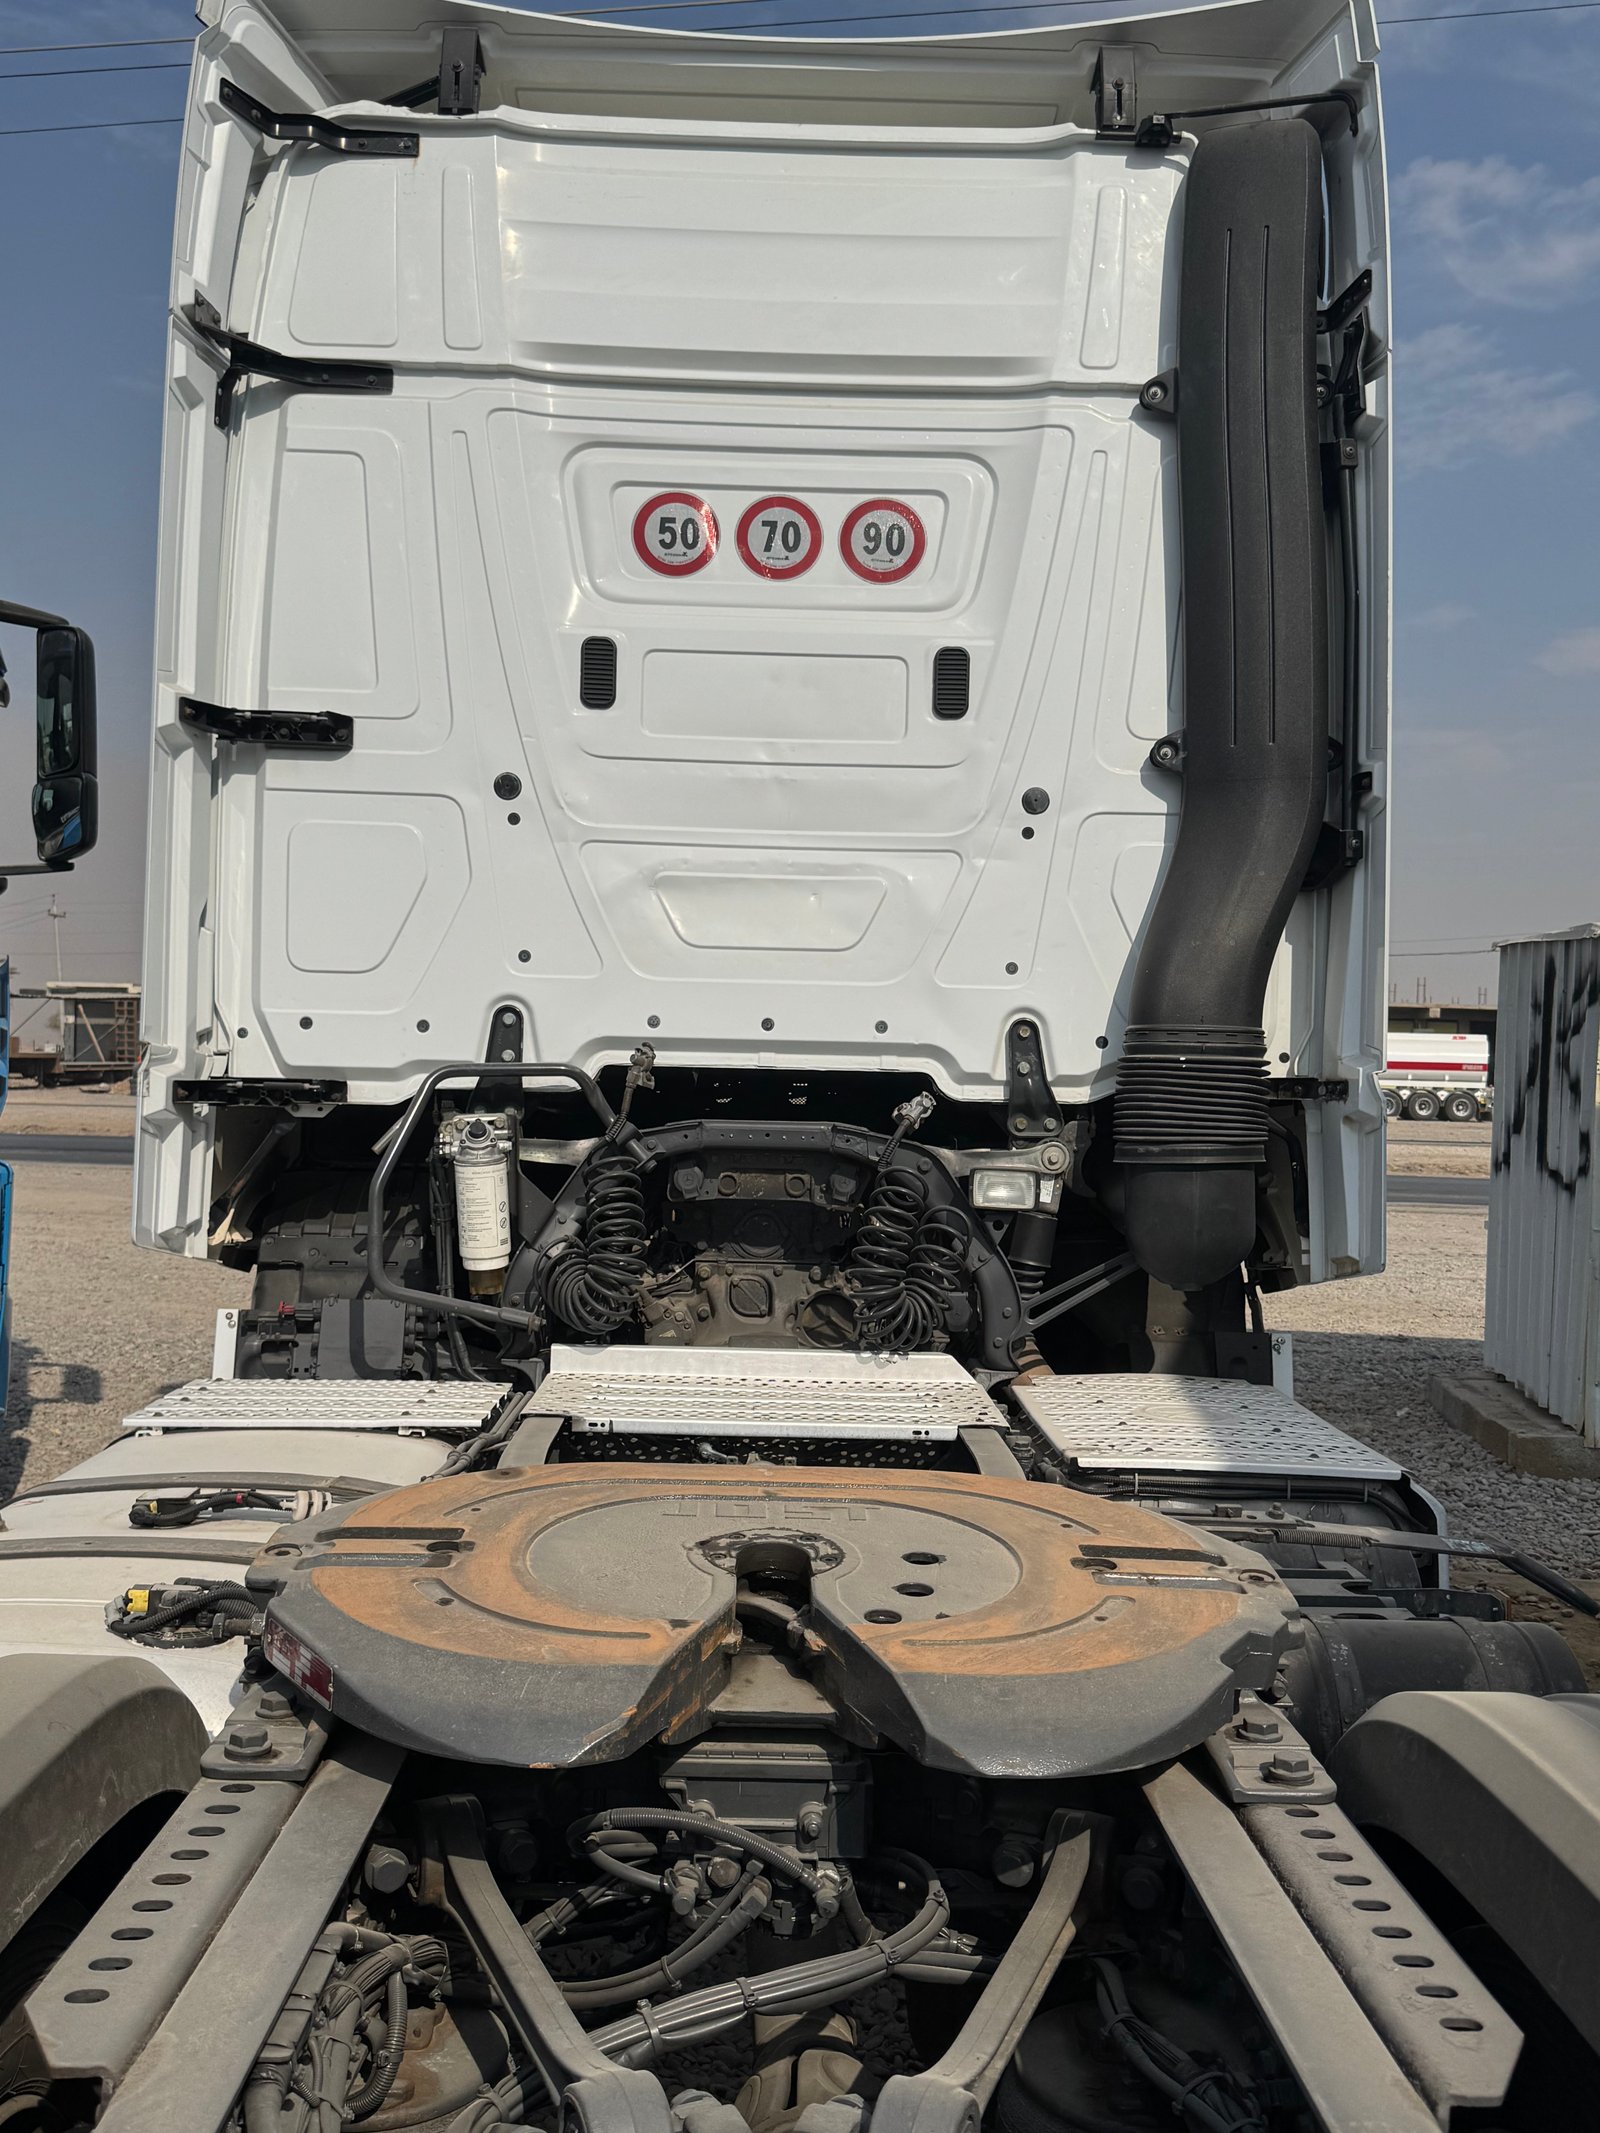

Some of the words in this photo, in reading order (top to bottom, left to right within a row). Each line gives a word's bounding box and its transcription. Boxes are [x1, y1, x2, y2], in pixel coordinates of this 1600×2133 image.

[658, 516, 700, 550] 50
[761, 520, 801, 553] 70
[863, 521, 905, 556] 90
